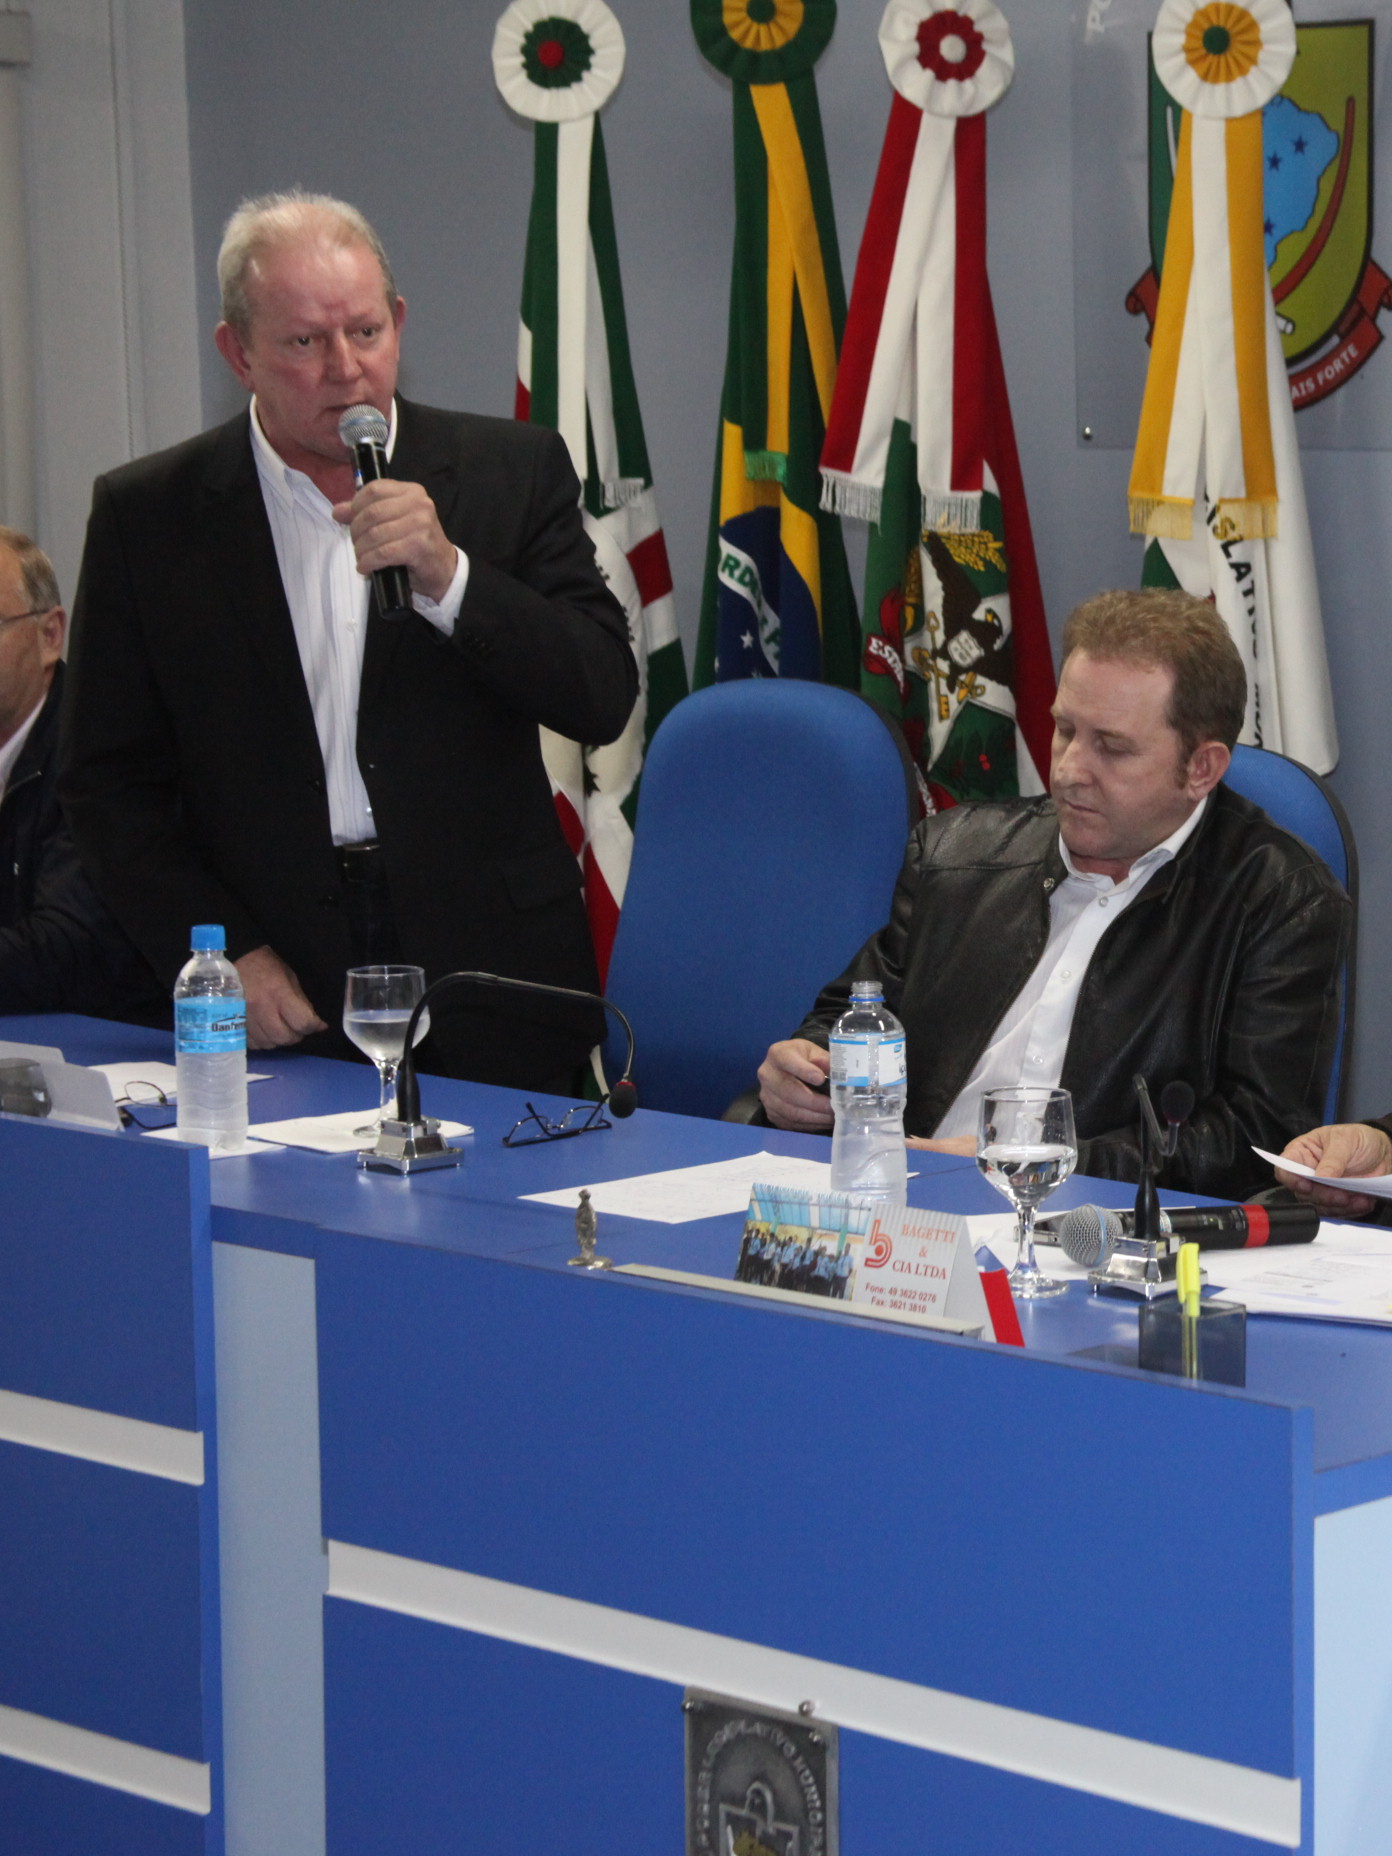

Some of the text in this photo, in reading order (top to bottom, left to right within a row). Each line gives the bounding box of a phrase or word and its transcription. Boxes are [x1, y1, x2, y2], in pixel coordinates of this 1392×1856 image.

[1291, 343, 1359, 399] AIS FORTE
[901, 1224, 957, 1244] BAGETTI
[918, 1245, 928, 1257] &
[892, 1259, 947, 1280] CIA LTDA
